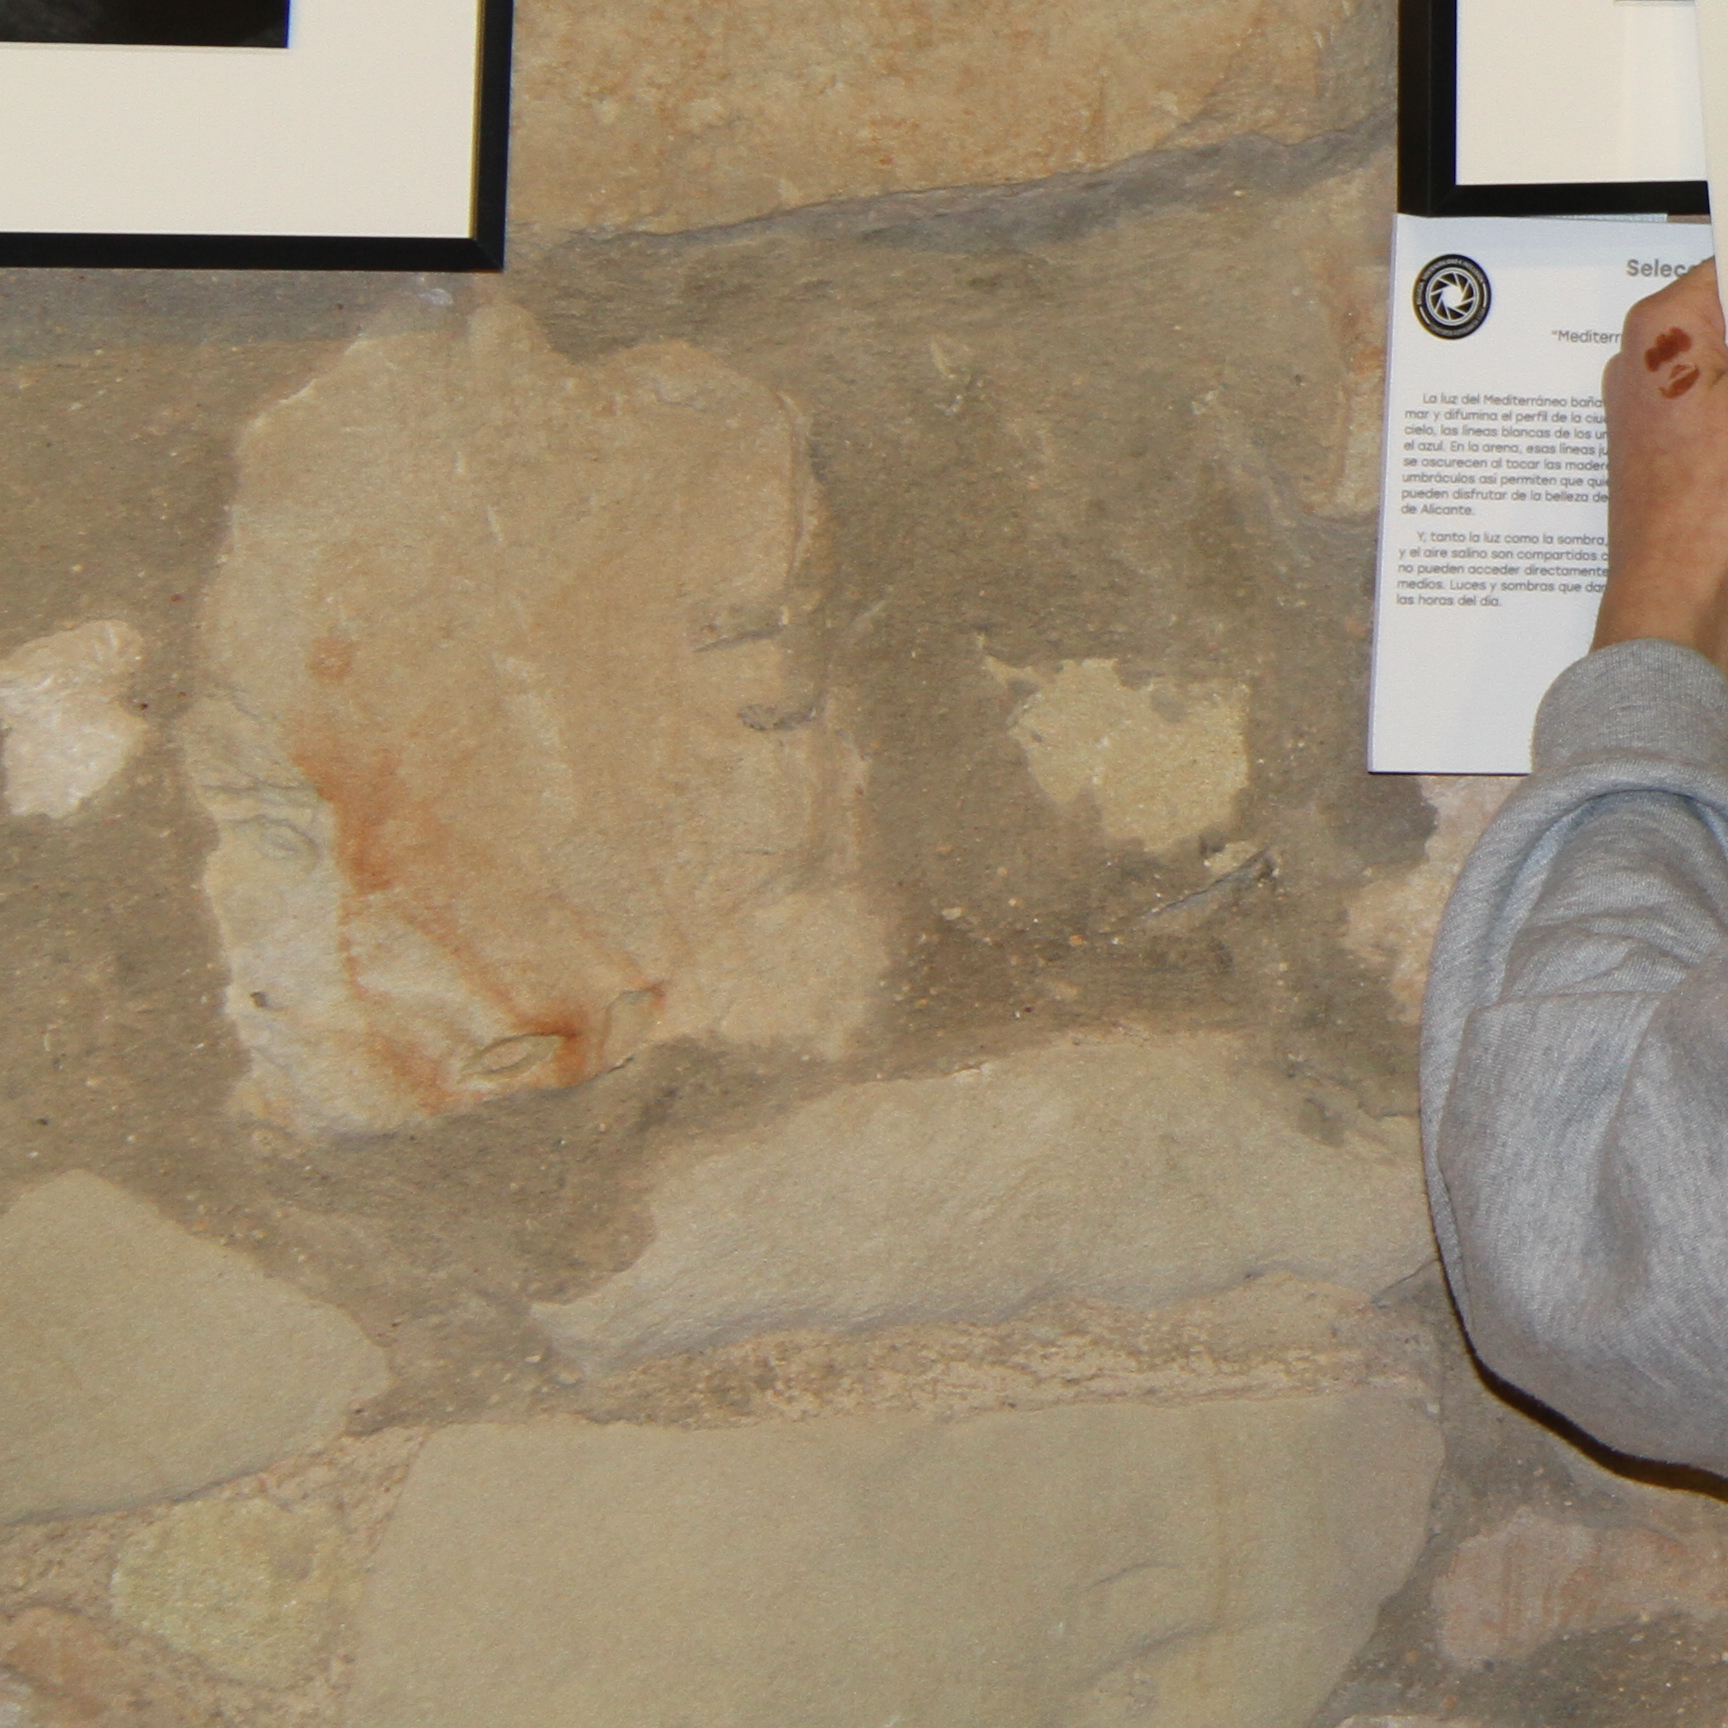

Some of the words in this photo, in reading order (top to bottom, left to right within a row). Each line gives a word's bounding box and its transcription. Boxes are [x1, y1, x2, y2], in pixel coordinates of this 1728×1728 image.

[1626, 258, 1697, 277] Selec
[1551, 329, 1622, 343] "Mediterr
[1423, 393, 1437, 404] La
[1440, 393, 1458, 404] luz
[1461, 393, 1480, 405] del
[1483, 394, 1566, 407] Mediterráneo
[1404, 410, 1429, 419] mar
[1434, 411, 1440, 423] y
[1444, 408, 1498, 421] difumina
[1501, 410, 1513, 421] el
[1515, 410, 1548, 425] perfil
[1551, 411, 1567, 422] de
[1571, 411, 1581, 422] la
[1585, 412, 1606, 423] ciu
[1404, 424, 1437, 438] cielo,
[1440, 425, 1458, 436] las
[1462, 425, 1498, 437] líneas
[1501, 426, 1550, 438] blancas
[1554, 427, 1570, 438] de
[1574, 427, 1591, 439] los
[1403, 439, 1414, 451] el
[1418, 440, 1445, 451] azul.
[1450, 440, 1465, 452] En
[1468, 441, 1479, 452] la
[1483, 444, 1522, 455] arena,
[1526, 445, 1555, 454] esas
[1559, 443, 1596, 455] líneas
[1403, 458, 1417, 467] se
[1421, 459, 1488, 468] oscurecen
[1491, 457, 1502, 468] al
[1506, 458, 1540, 469] tocar
[1544, 458, 1561, 470] las
[1402, 471, 1475, 484] umbráculos
[1479, 473, 1497, 484] así
[1500, 474, 1558, 489] permiten
[1560, 477, 1583, 490] que
[1401, 488, 1449, 503] pueden
[1452, 489, 1507, 501] disfrutar
[1510, 490, 1527, 501] de
[1530, 490, 1541, 501] la
[1545, 490, 1589, 502] belleza
[1400, 502, 1417, 514] de
[1420, 503, 1475, 515] Alicante.
[1416, 531, 1426, 544] Y,
[1430, 532, 1465, 543] tanto
[1469, 532, 1480, 543] la
[1483, 532, 1500, 544] luz
[1504, 536, 1539, 544] como
[1543, 533, 1553, 544] la
[1557, 534, 1608, 547] sombra,
[1398, 549, 1405, 561] y
[1409, 547, 1420, 558] el
[1423, 547, 1447, 558] aire
[1451, 547, 1488, 559] salino
[1491, 551, 1514, 560] son
[1517, 549, 1597, 565] compartidos
[1398, 565, 1414, 573] no
[1417, 562, 1465, 578] pueden
[1468, 563, 1520, 575] acceder
[1396, 577, 1445, 589] medios.
[1450, 578, 1486, 590] Luces
[1489, 582, 1496, 594] y
[1500, 579, 1555, 591] sombras
[1558, 583, 1582, 596] que
[1396, 594, 1414, 605] las
[1418, 594, 1454, 606] horas
[1457, 595, 1476, 606] del
[1480, 595, 1501, 606] día.
